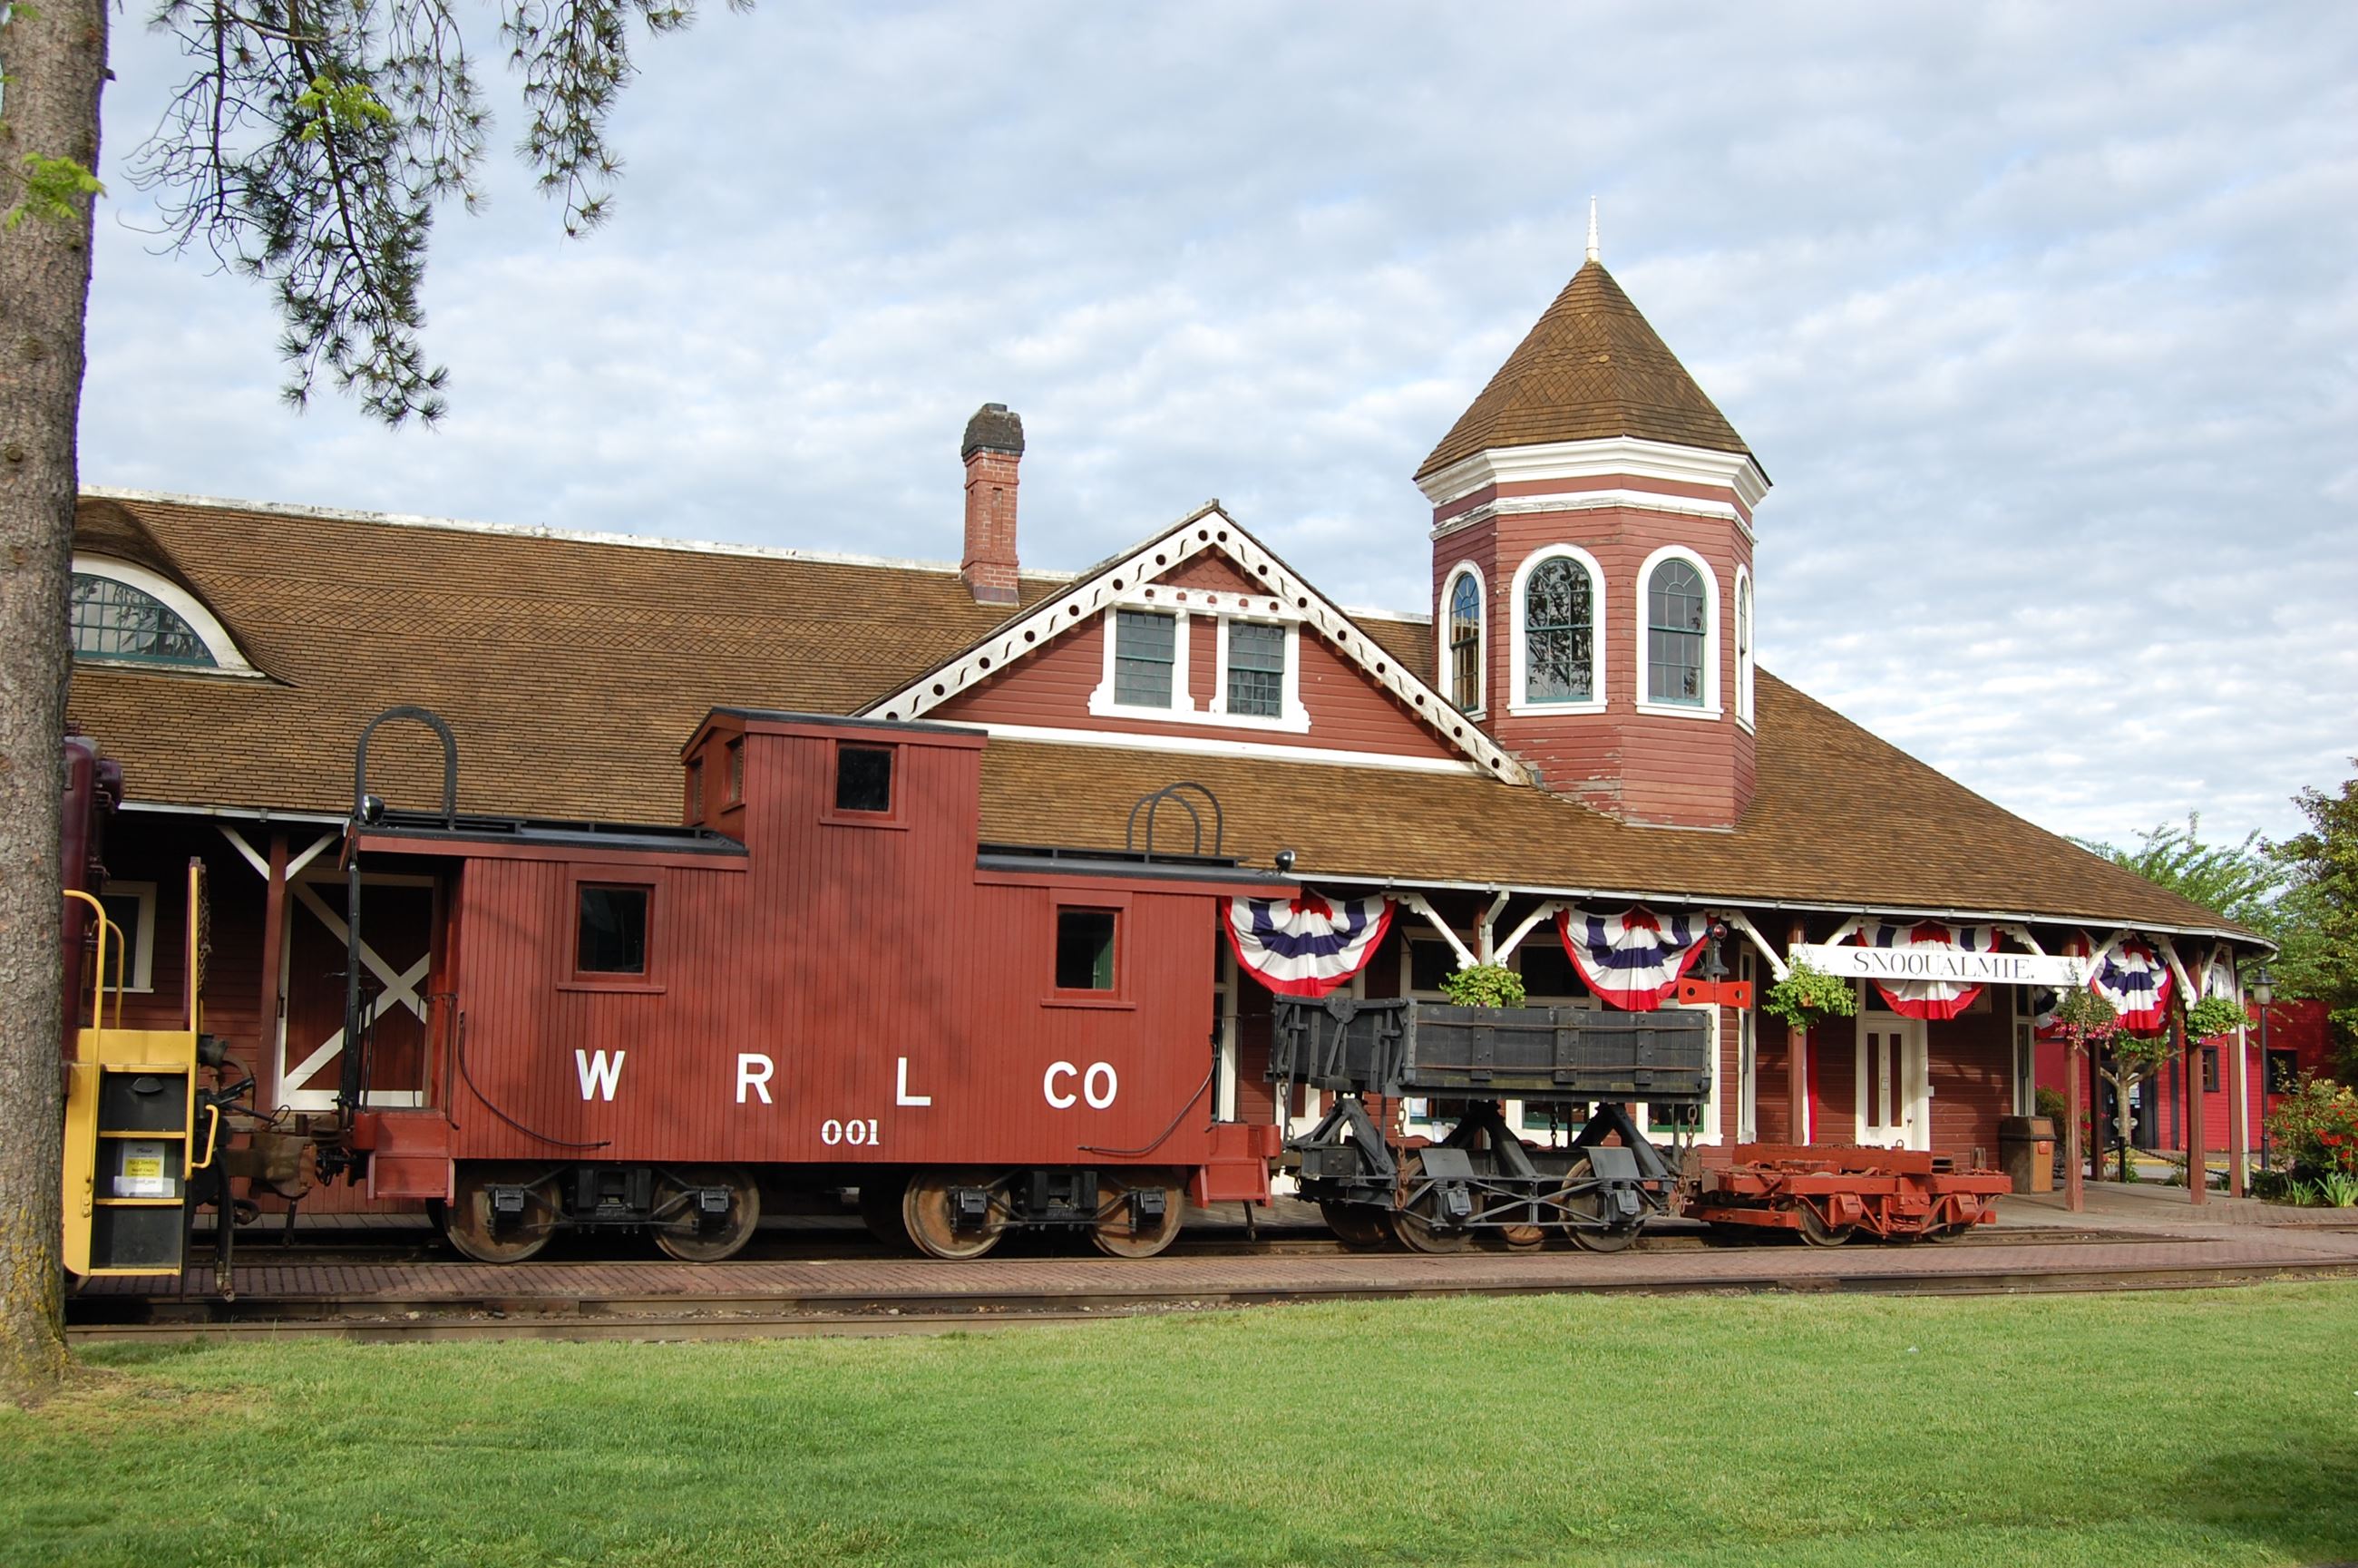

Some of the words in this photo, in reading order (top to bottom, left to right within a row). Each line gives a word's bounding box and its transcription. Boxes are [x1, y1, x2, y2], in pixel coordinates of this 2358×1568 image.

[575, 1048, 626, 1102] W
[736, 1052, 775, 1105] R
[896, 1057, 931, 1106] L
[1043, 1060, 1118, 1110] CO
[821, 1118, 880, 1145] 001
